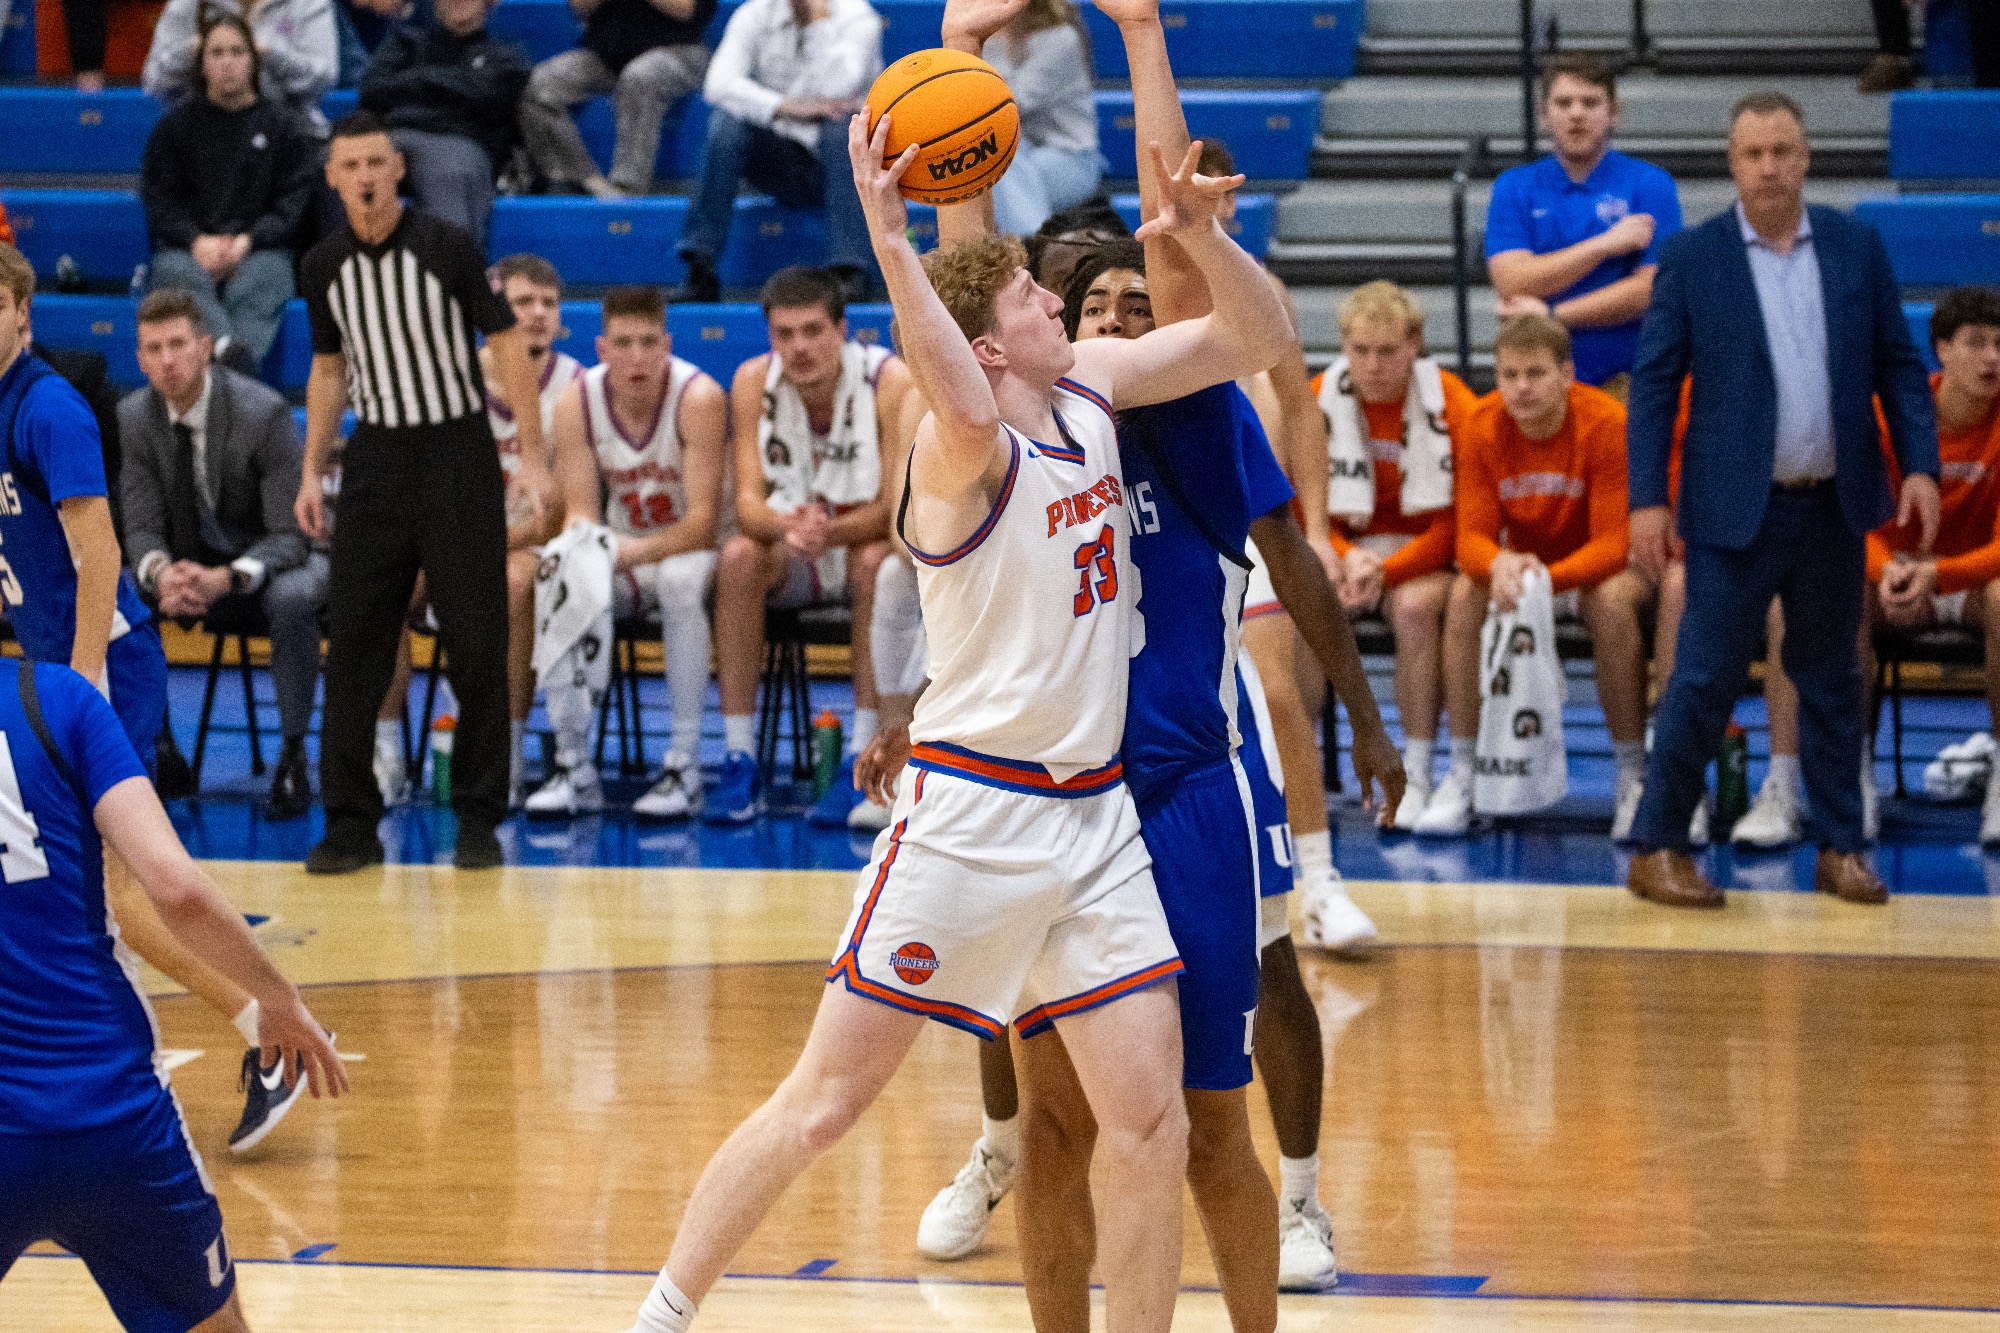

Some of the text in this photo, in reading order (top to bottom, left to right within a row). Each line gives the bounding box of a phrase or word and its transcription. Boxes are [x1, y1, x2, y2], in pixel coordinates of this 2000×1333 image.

[926, 131, 999, 181] NCAA
[621, 491, 679, 529] 12
[1045, 474, 1123, 539] PINEES
[1073, 523, 1119, 619] 33
[888, 951, 941, 970] PIONEERS
